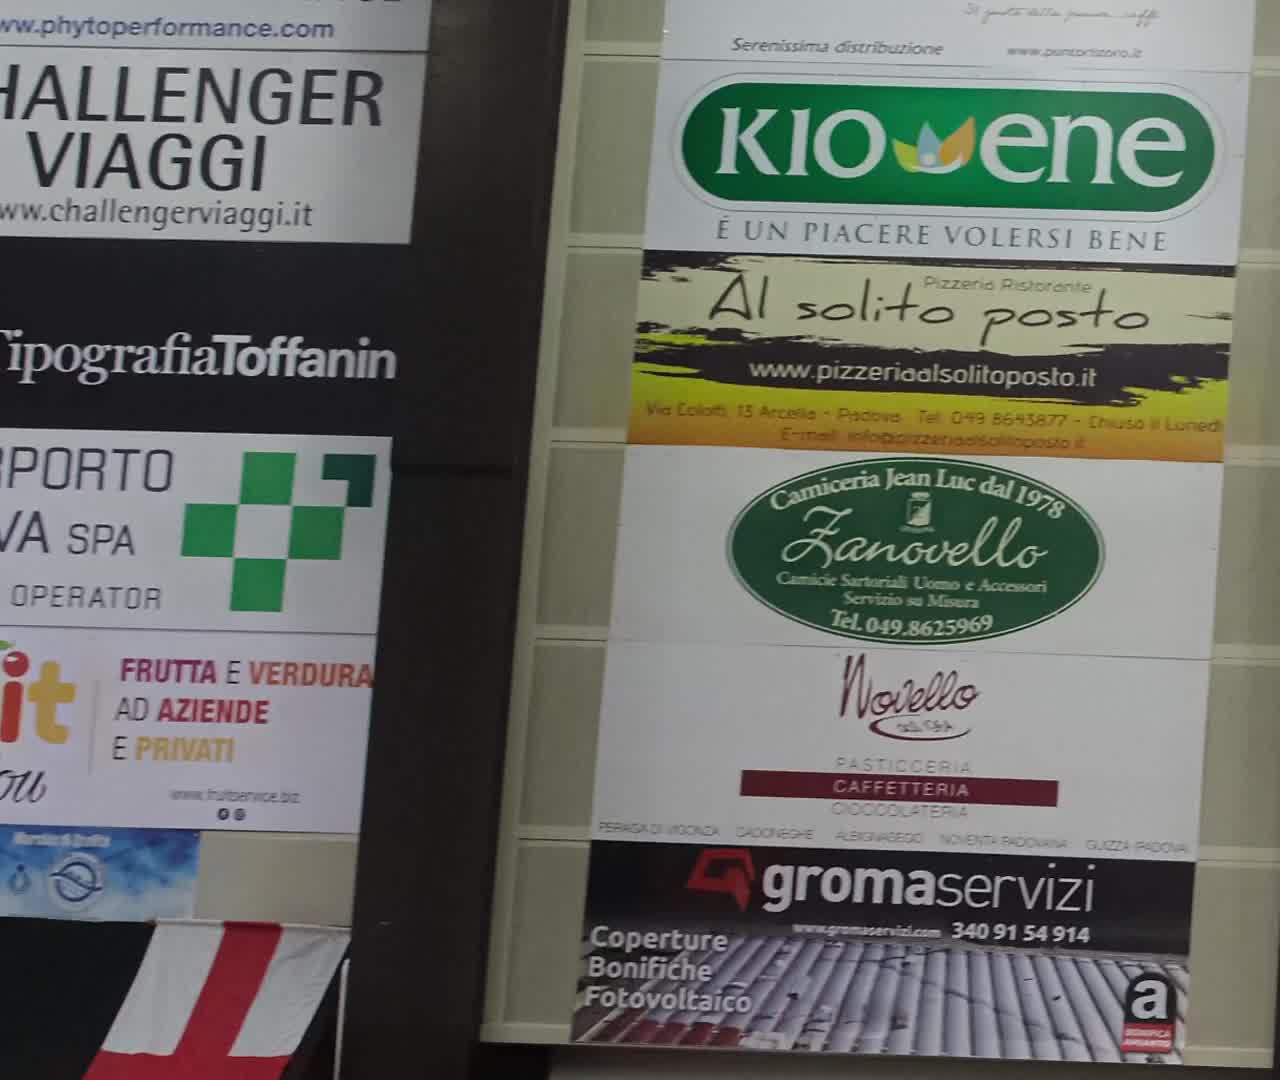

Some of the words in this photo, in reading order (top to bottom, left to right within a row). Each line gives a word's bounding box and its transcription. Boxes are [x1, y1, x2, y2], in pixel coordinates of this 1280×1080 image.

[730, 38, 829, 53] Serenissima
[835, 39, 944, 56] distribuzione
[27, 131, 266, 191] VIAGGI
[745, 220, 787, 241] UN
[804, 222, 930, 246] PIACERE
[944, 226, 1073, 249] VOLERSI
[1089, 230, 1168, 252] BENE
[924, 275, 993, 292] Pizzeria
[1000, 278, 1093, 294] Ristorante
[709, 273, 768, 321] Al
[796, 278, 955, 323] solito
[980, 288, 1149, 346] posto
[750, 360, 1097, 389] www.pizzeriaalsolitoposto.it
[952, 411, 985, 425] 049
[0, 446, 173, 493] PORTO
[769, 469, 881, 511] Camiceria
[884, 468, 931, 490] Jean
[937, 469, 976, 491] Luc
[979, 473, 1012, 501] dal
[1014, 484, 1067, 520] 1978
[67, 523, 135, 556] SPA
[781, 505, 1048, 569] Zanovello
[11, 584, 162, 610] OPERATOR
[914, 575, 960, 591] Uomo
[978, 578, 1047, 593] Accessori
[844, 591, 902, 607] Servizio
[928, 594, 979, 609] Misura
[120, 658, 217, 684] FRUTTA
[226, 660, 241, 684] E
[250, 661, 374, 688] VERDURA
[114, 697, 149, 722] AD
[157, 698, 270, 724] AZIENDE
[112, 735, 128, 760] E
[135, 736, 236, 763] PRIVATI
[835, 756, 971, 775] PASTICCERIA
[832, 779, 970, 798] CAFFETTERIA
[831, 801, 968, 819] CIOCCOLATERIA
[762, 862, 1096, 913] gromaservizi
[590, 925, 728, 952] Coperture
[792, 924, 941, 938] www.gromaservizi.com
[952, 922, 989, 940] 340
[993, 924, 1017, 940] 91
[1023, 925, 1048, 941] 54
[1052, 926, 1091, 943] 914
[588, 956, 712, 982] Bonifiche
[584, 986, 752, 1013] Fotovoltaico
